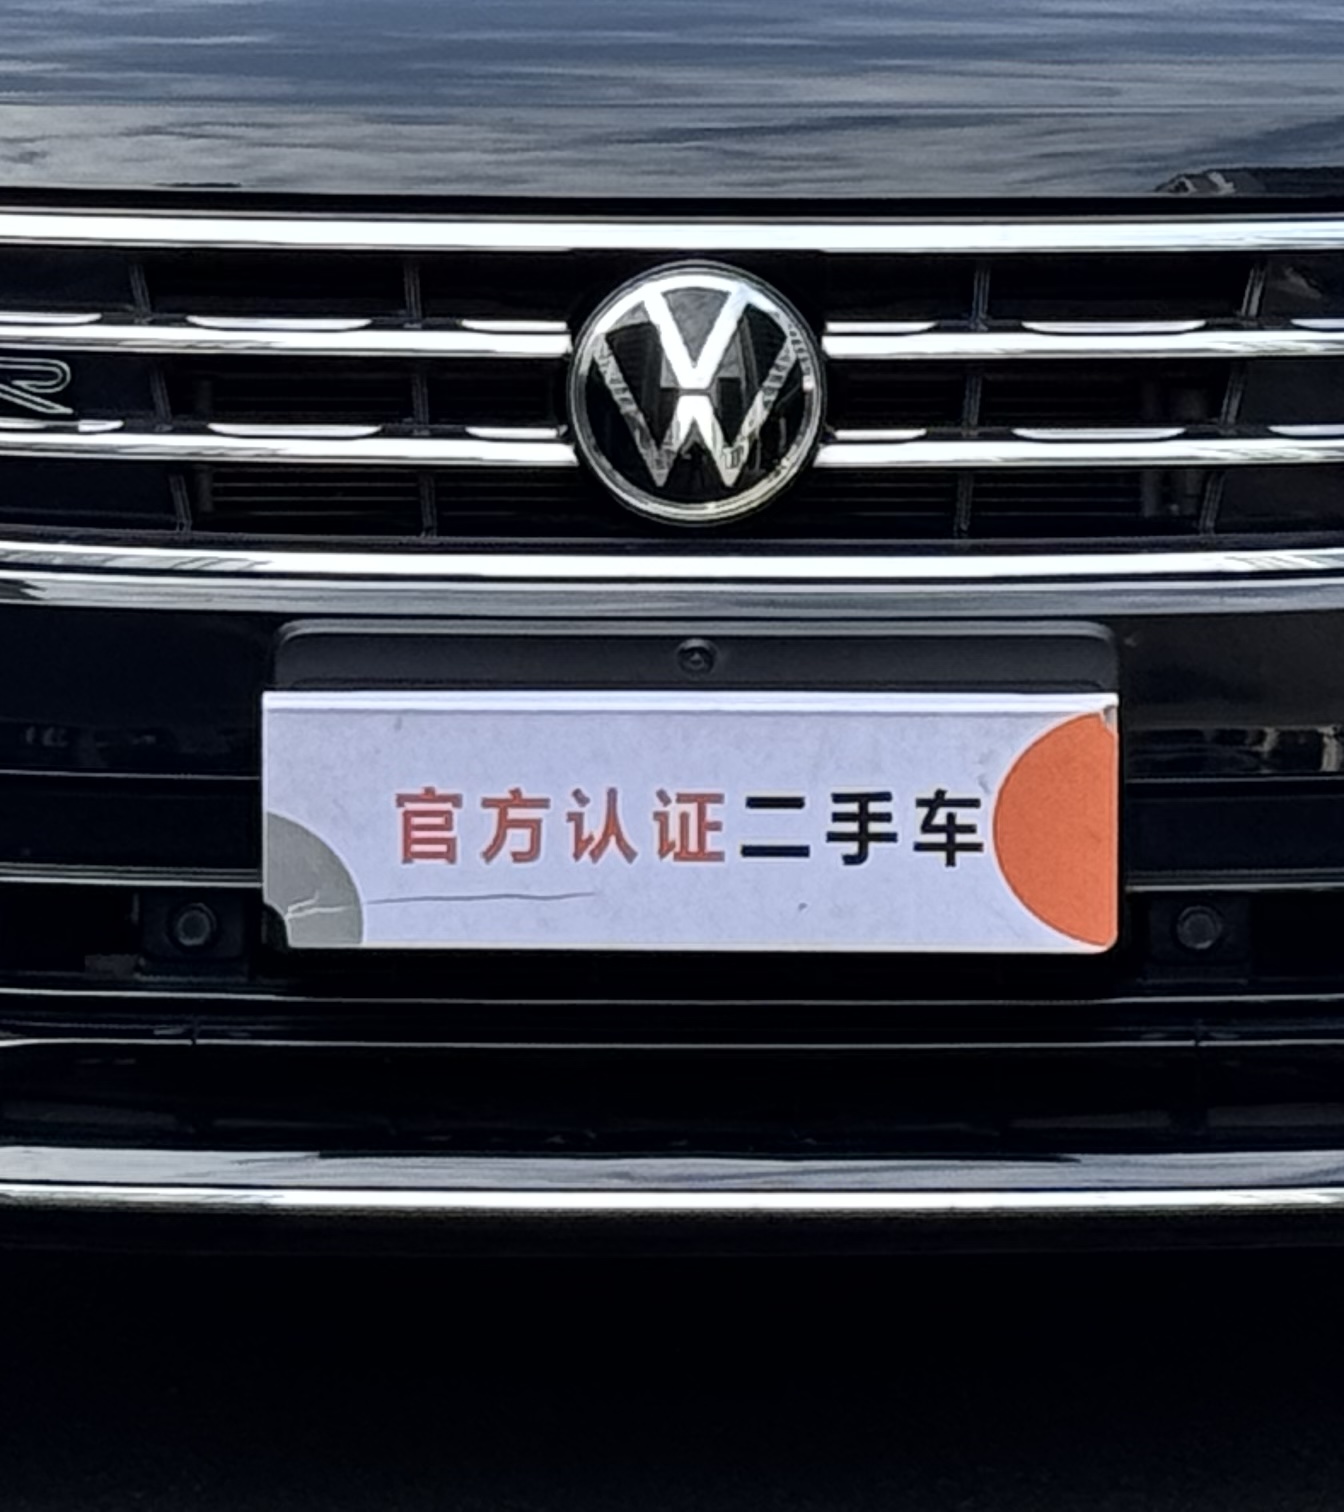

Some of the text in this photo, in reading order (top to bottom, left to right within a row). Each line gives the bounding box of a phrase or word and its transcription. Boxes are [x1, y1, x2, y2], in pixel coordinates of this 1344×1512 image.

[584, 274, 806, 492] VW
[395, 787, 984, 867] 官方认证二手车
